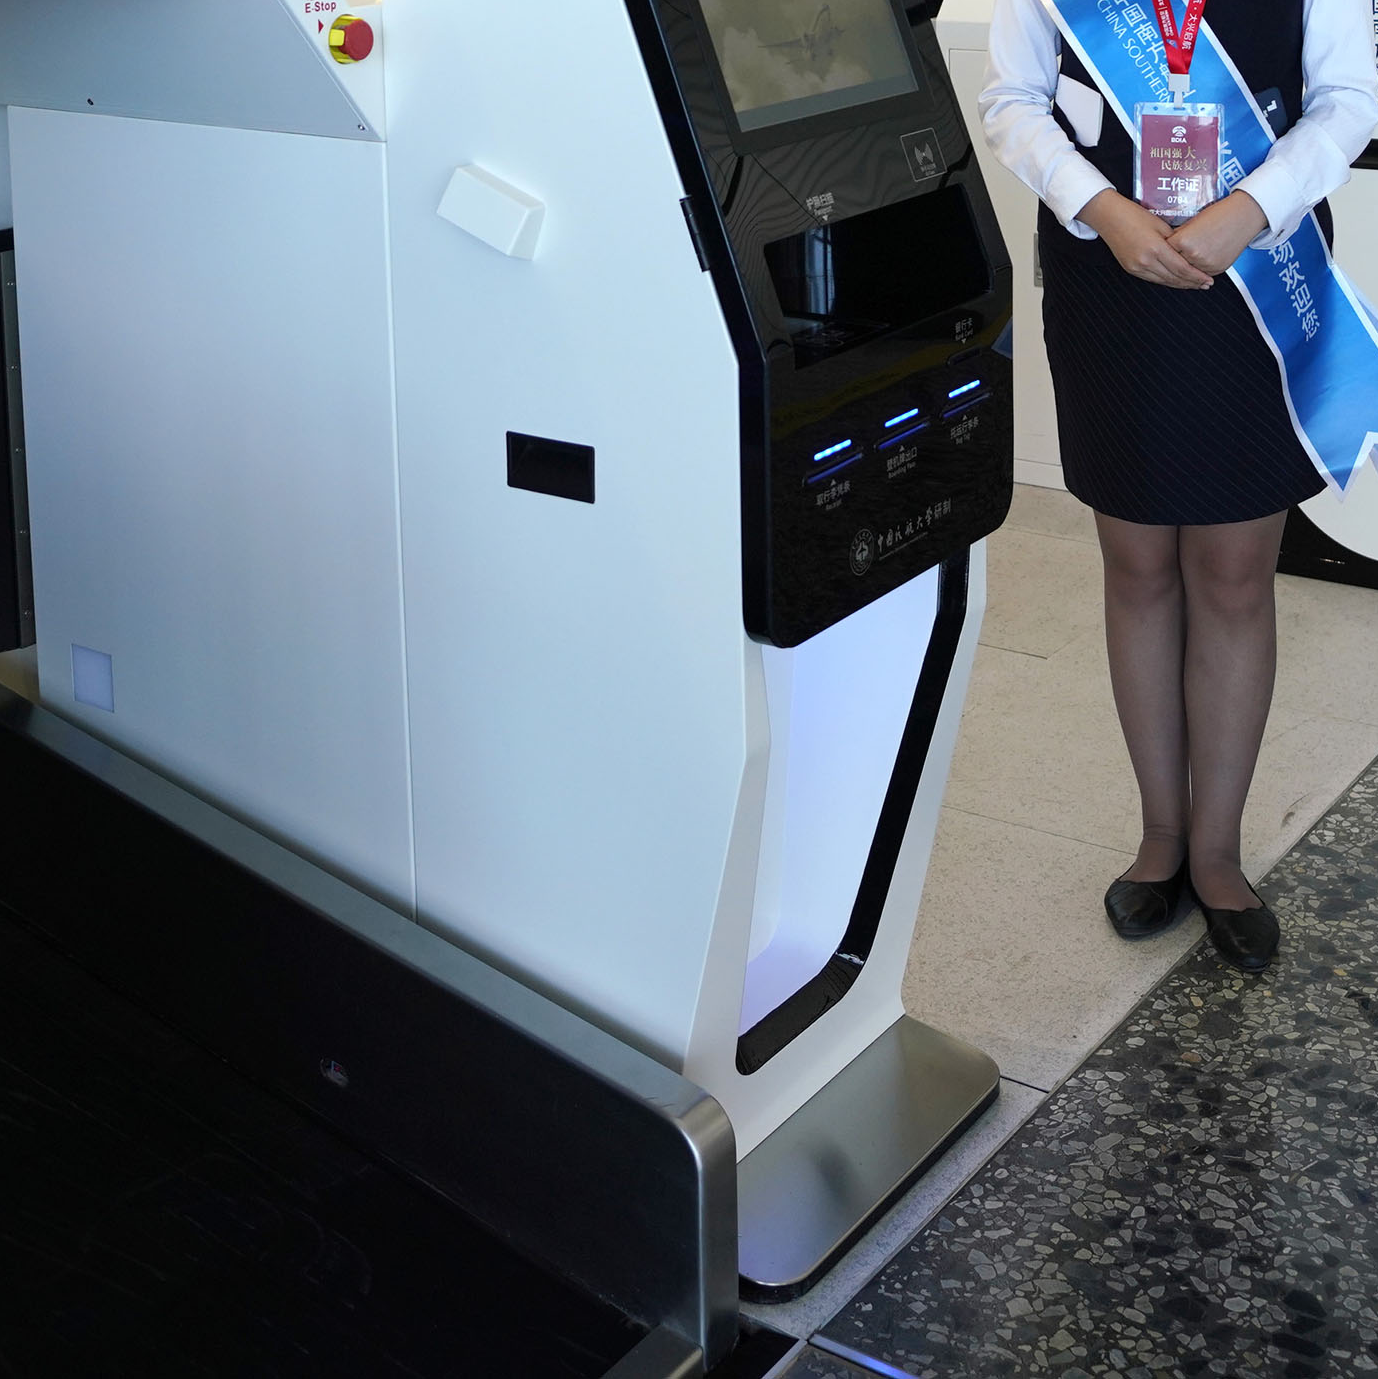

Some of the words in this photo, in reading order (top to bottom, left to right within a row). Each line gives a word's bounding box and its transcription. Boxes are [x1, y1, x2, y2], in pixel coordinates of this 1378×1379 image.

[304, 1, 337, 14] E-Stop
[1149, 146, 1197, 159] 祖国强大
[1161, 158, 1208, 171] 民族复兴
[1157, 177, 1200, 192] 工作证
